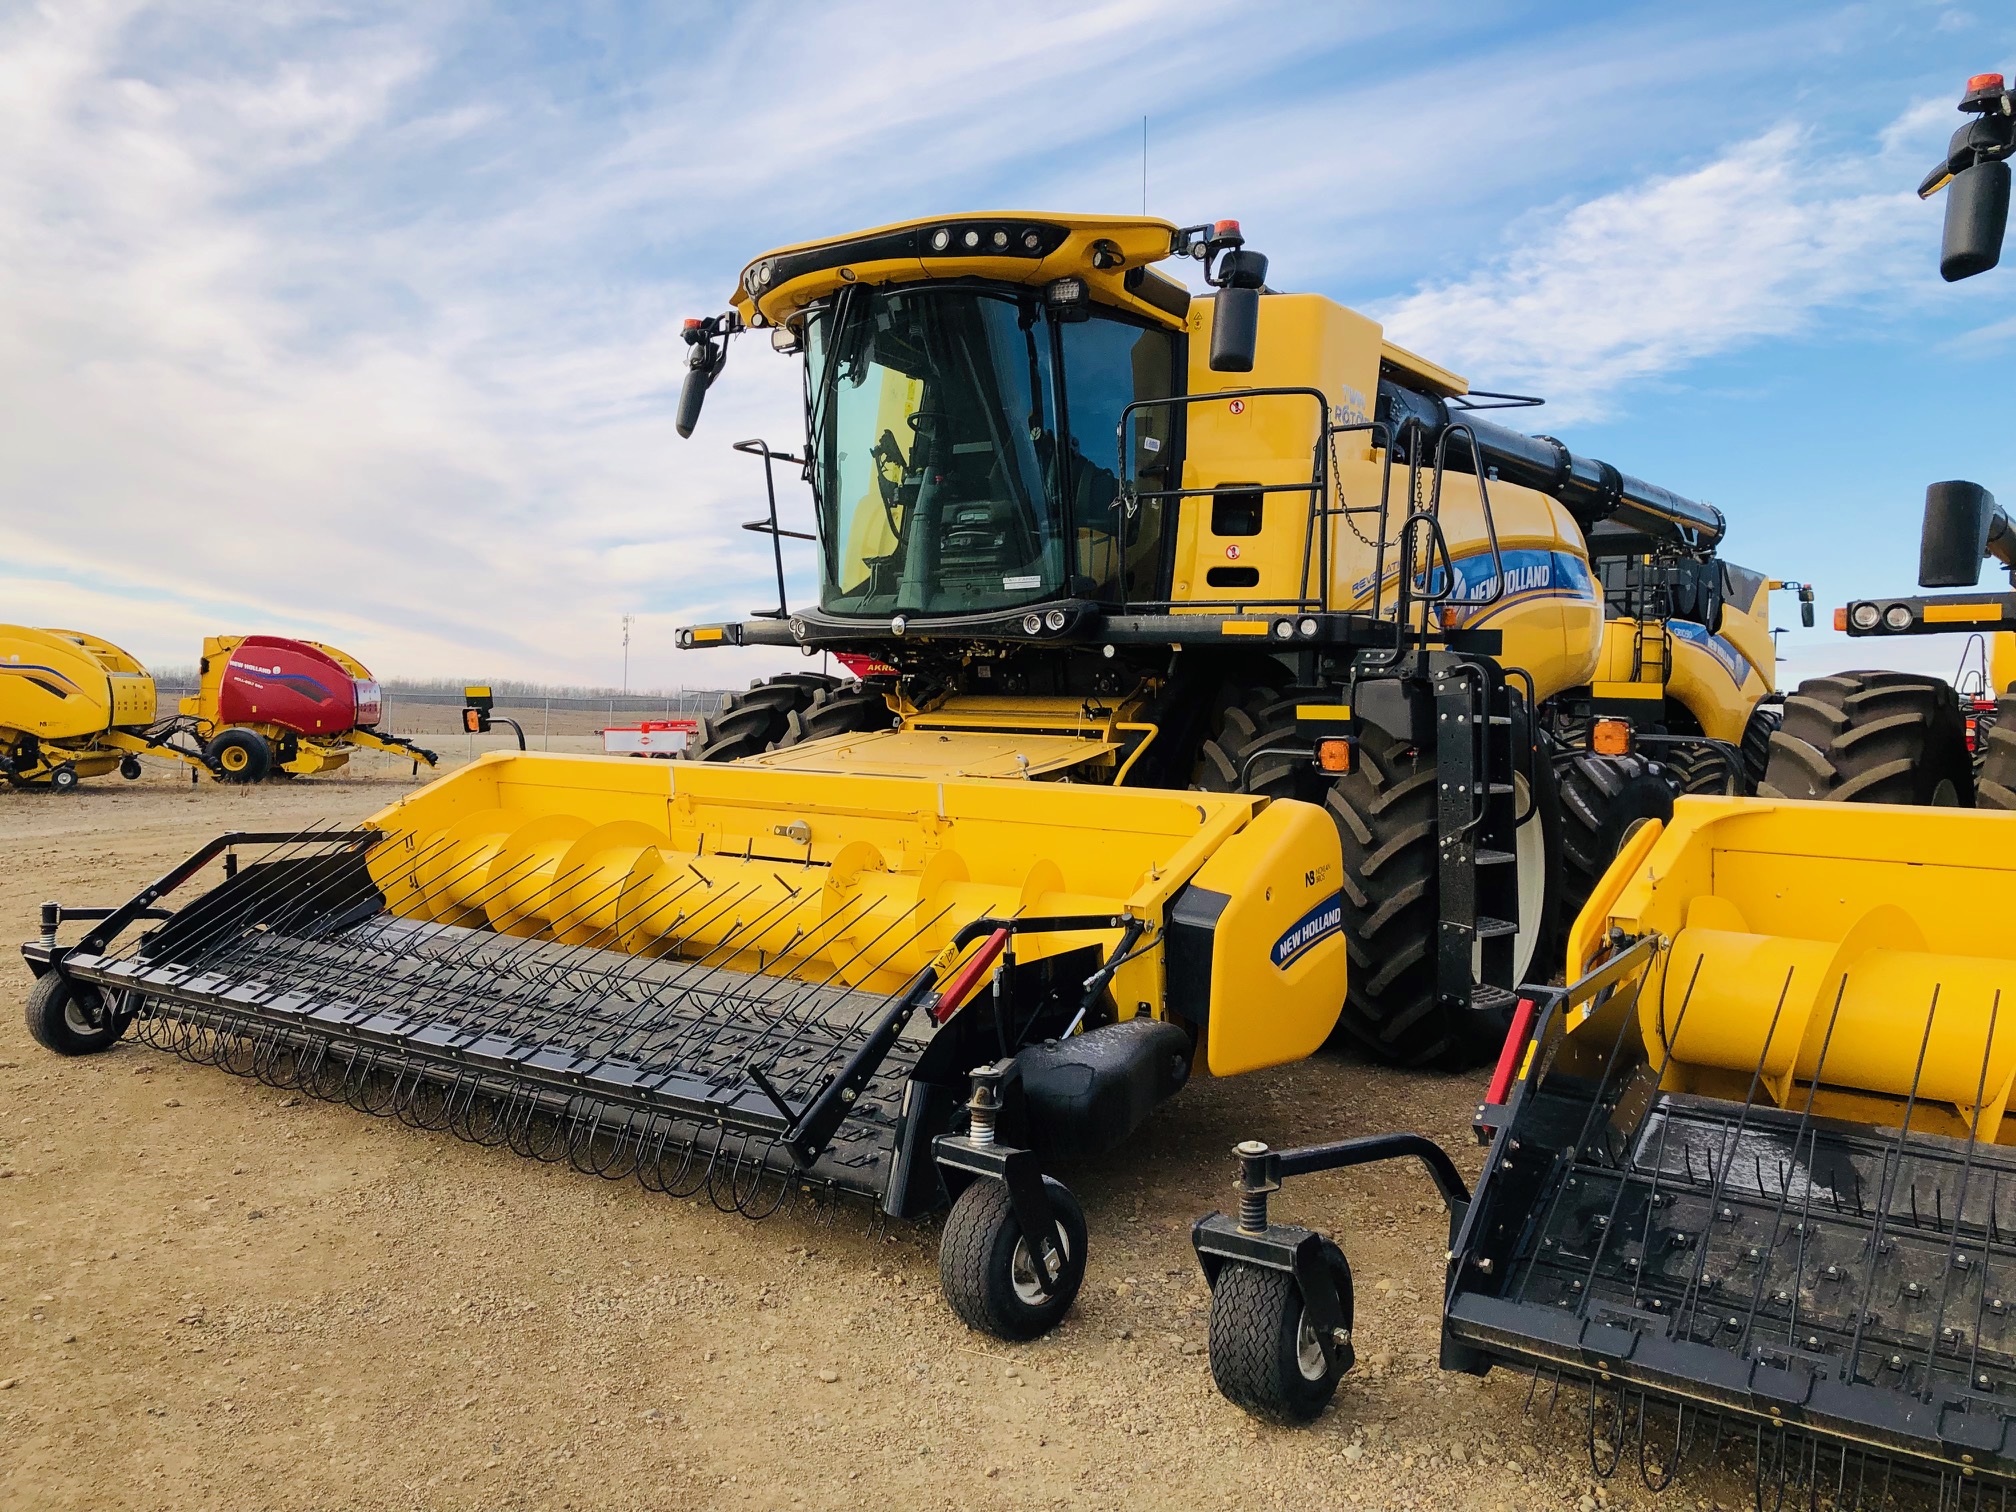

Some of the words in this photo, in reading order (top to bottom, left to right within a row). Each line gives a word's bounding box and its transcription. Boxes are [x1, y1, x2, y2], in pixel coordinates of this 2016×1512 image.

[1469, 575, 1498, 615] NEW
[229, 660, 243, 668] NEW
[244, 663, 272, 674] HOLLAND
[1279, 930, 1302, 960] NEW
[1302, 907, 1341, 943] HOLLAND
